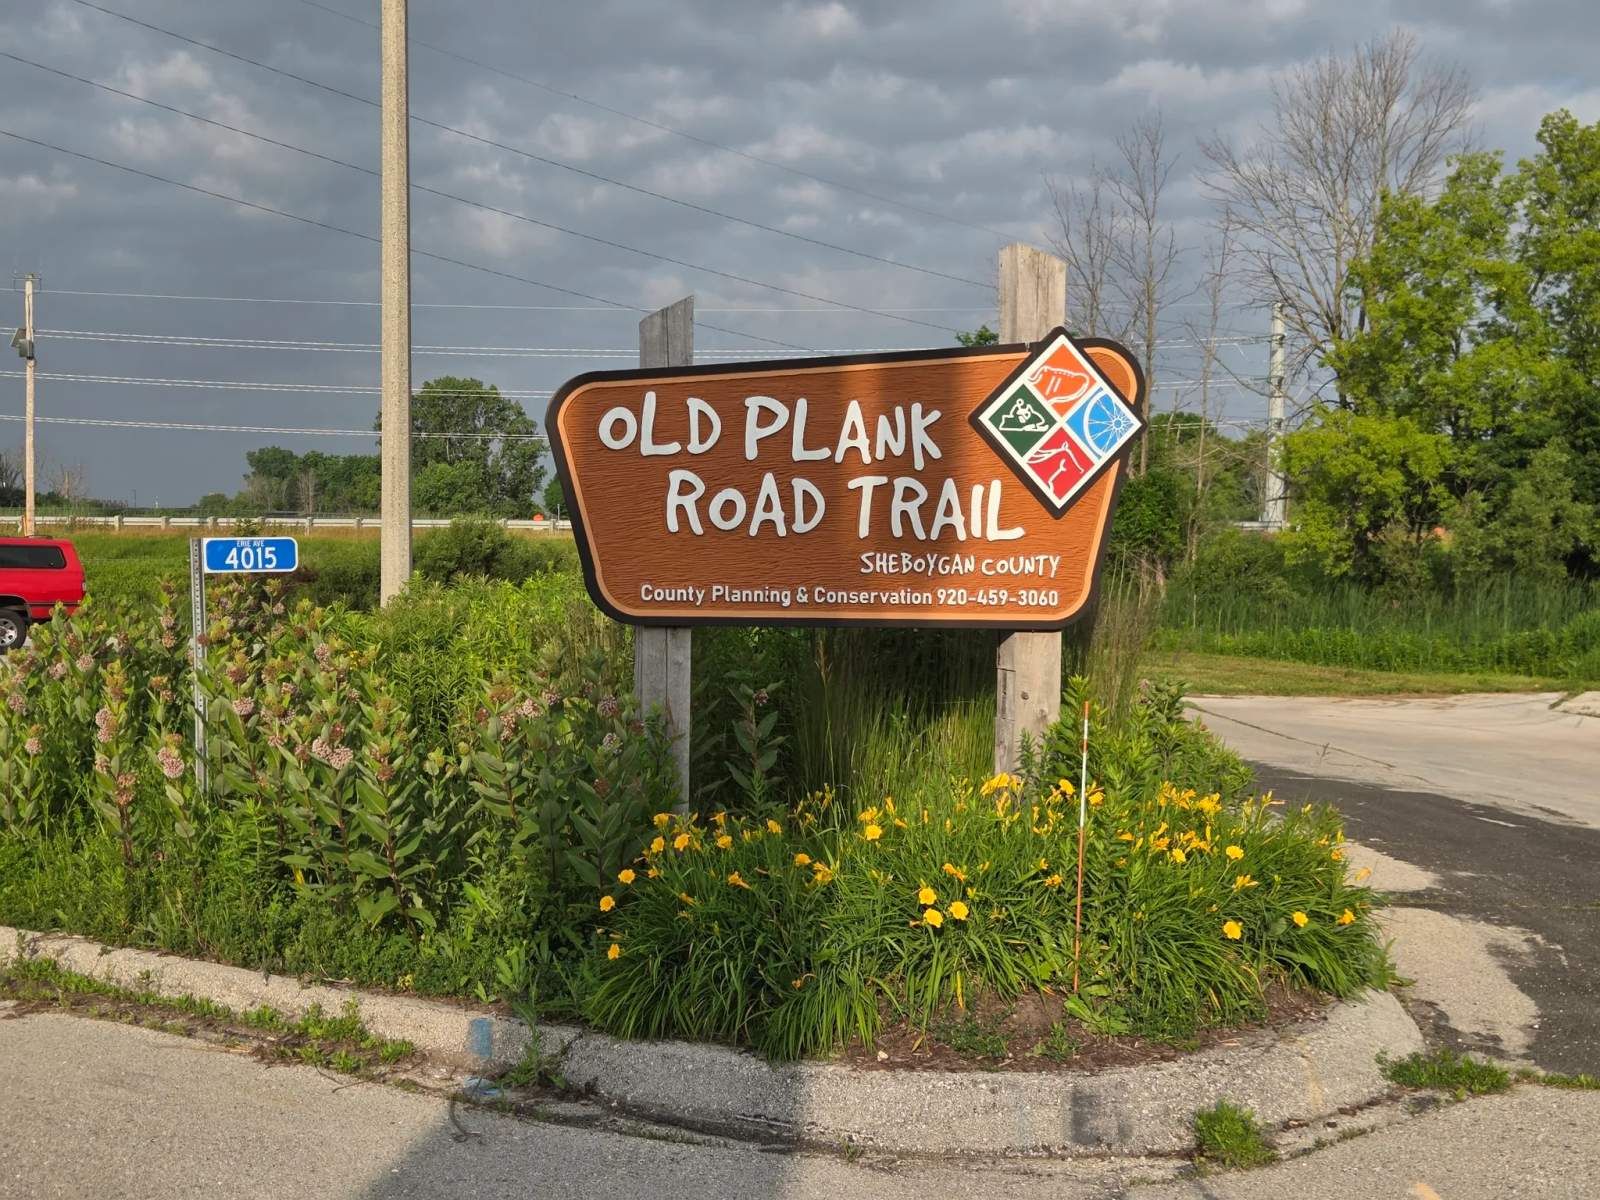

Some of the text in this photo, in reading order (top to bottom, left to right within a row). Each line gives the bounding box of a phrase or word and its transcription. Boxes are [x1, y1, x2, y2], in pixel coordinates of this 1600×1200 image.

[598, 391, 942, 470] OLD PLANK
[666, 470, 1025, 541] ROAD TRAIL
[225, 547, 277, 568] 4015
[860, 552, 1061, 578] SHEBOYGAN COUNTY
[640, 584, 1058, 607] County Planning & Conservation 920-459-3060
